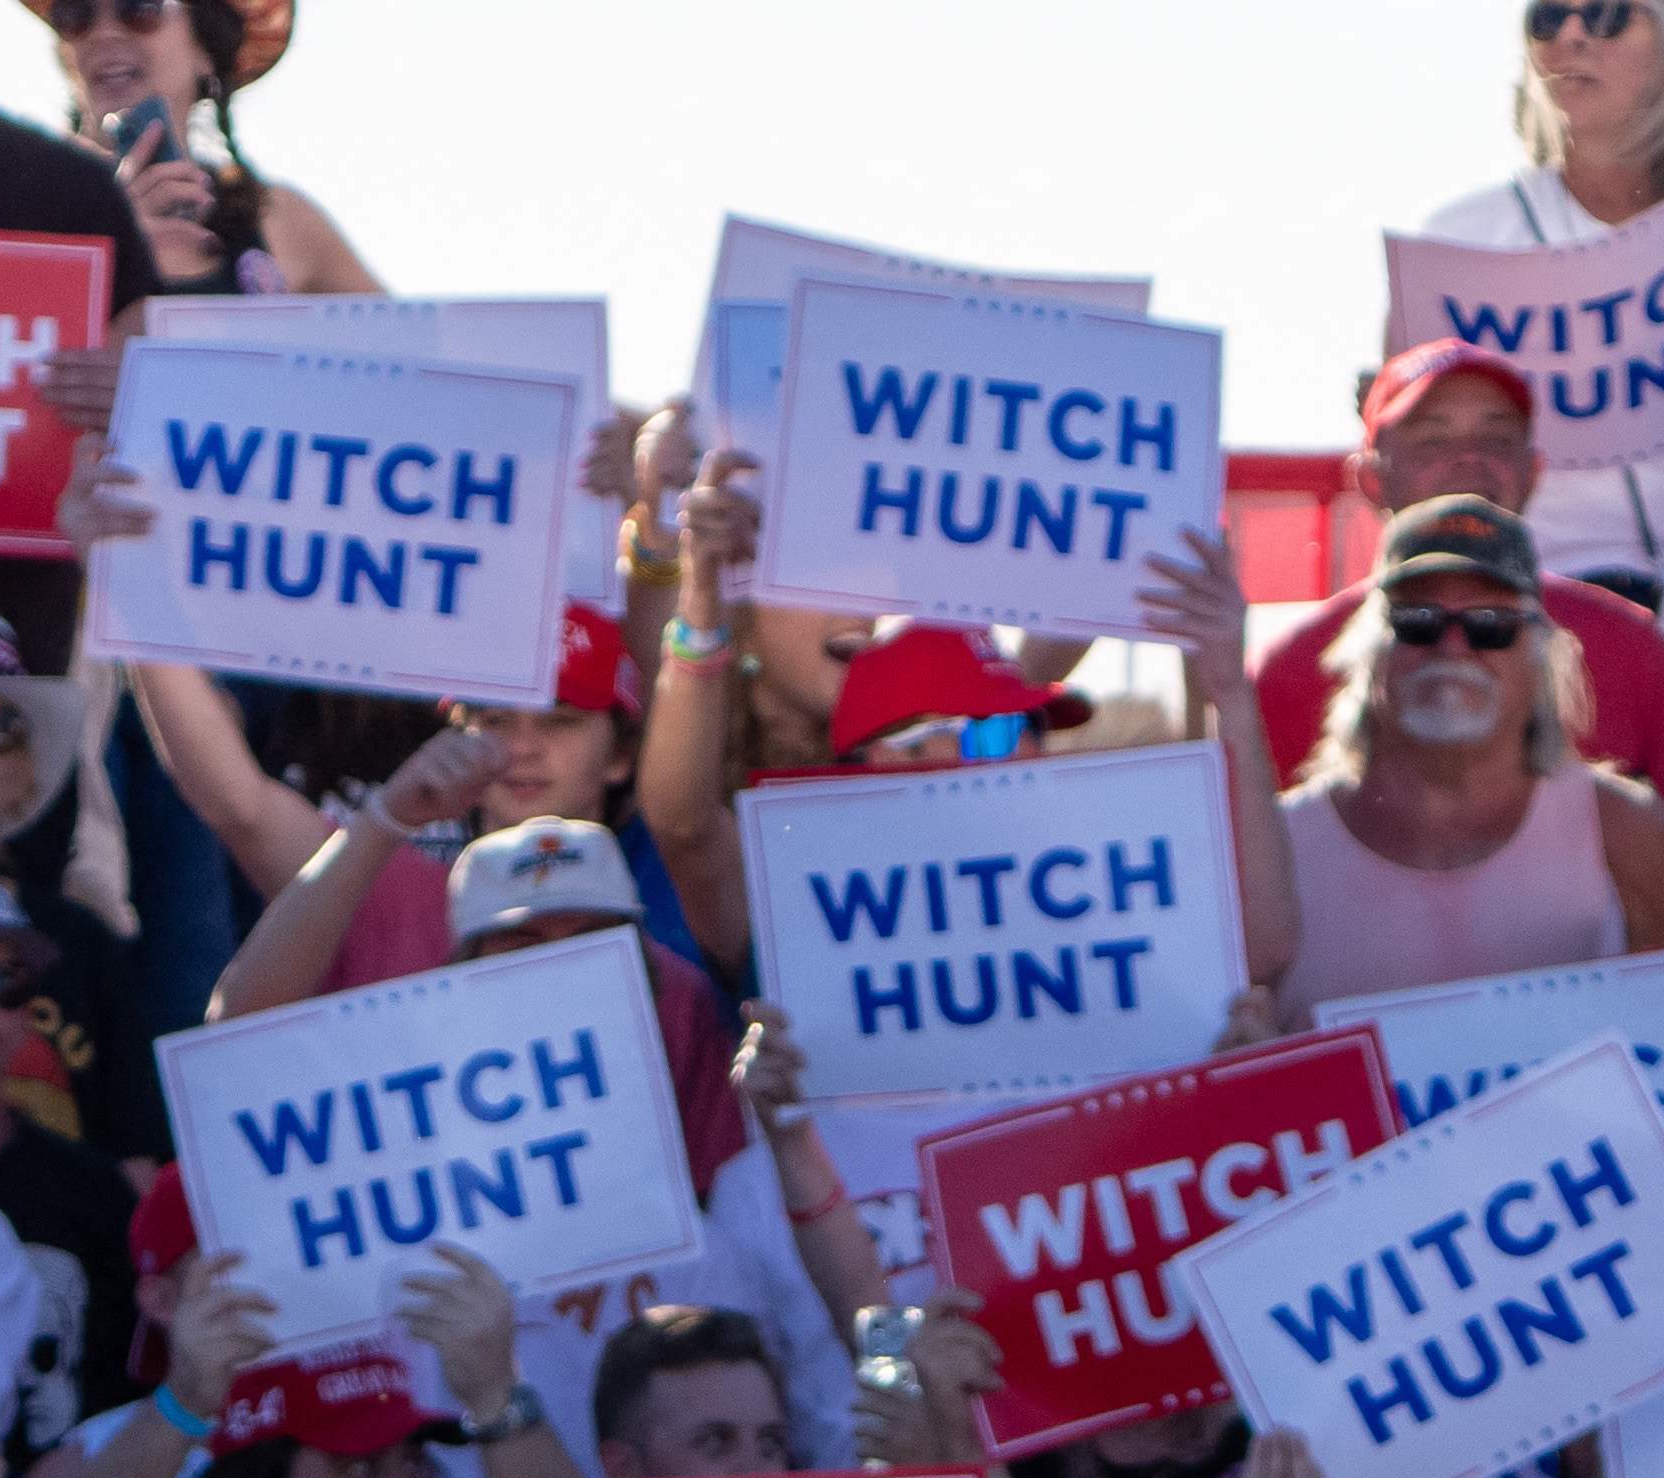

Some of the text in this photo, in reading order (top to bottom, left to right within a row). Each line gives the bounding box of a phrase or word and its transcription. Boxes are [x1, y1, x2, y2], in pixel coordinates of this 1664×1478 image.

[840, 362, 1178, 472] WITCH
[166, 420, 518, 525] WITCH
[858, 463, 1147, 562] HUNT
[188, 518, 480, 616] HUNT
[809, 835, 1177, 942] WITCH
[854, 938, 1153, 1036] HUNT
[234, 1028, 608, 1178] WITCH
[293, 1132, 588, 1268] HUNT
[981, 1118, 1353, 1282] WITCH
[1270, 1137, 1640, 1363] WITCH
[1033, 1270, 1194, 1368] HU
[1345, 1241, 1638, 1445] HUNT
